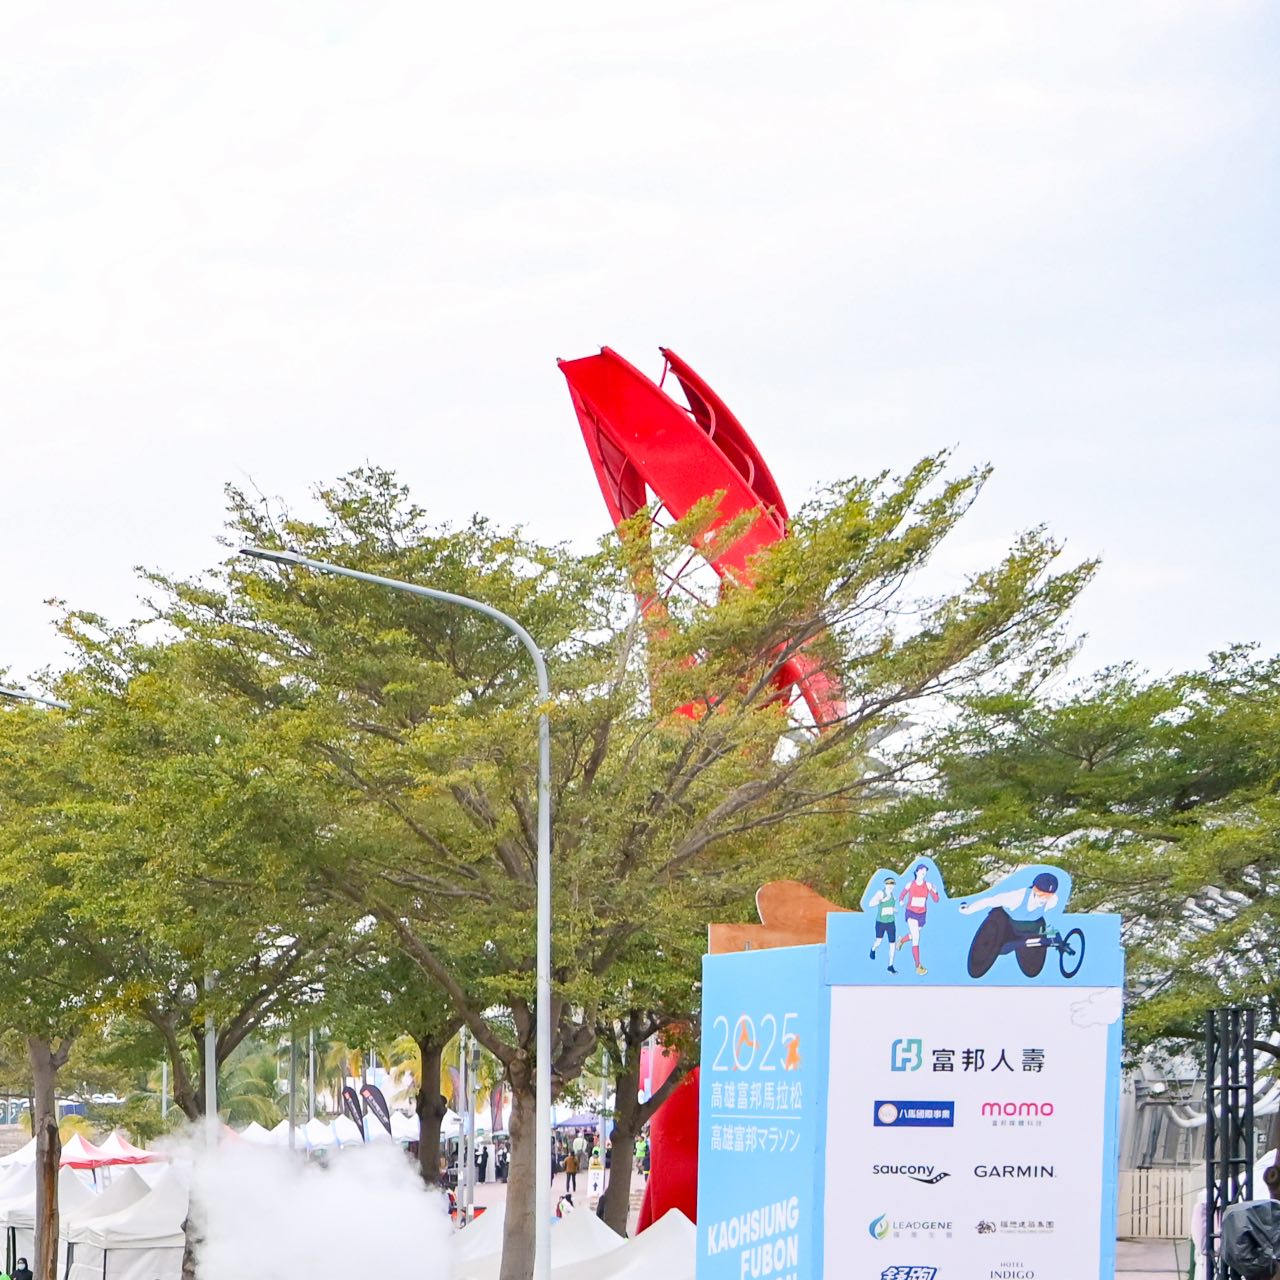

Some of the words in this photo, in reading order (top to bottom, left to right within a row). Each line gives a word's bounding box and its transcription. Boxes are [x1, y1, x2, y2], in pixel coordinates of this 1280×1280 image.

[932, 1048, 1045, 1073] 富邦人壽
[711, 1082, 802, 1110] 高雄富邦馬拉松
[981, 1102, 1054, 1116] momo
[711, 1124, 801, 1152] 高雄富邦マラソン
[873, 1164, 934, 1176] saucony
[974, 1165, 1054, 1178] GARMIN
[708, 1196, 799, 1256] KAOHSIUNG
[893, 1222, 952, 1230] LEADGENE
[990, 1270, 1034, 1279] INDIGO
